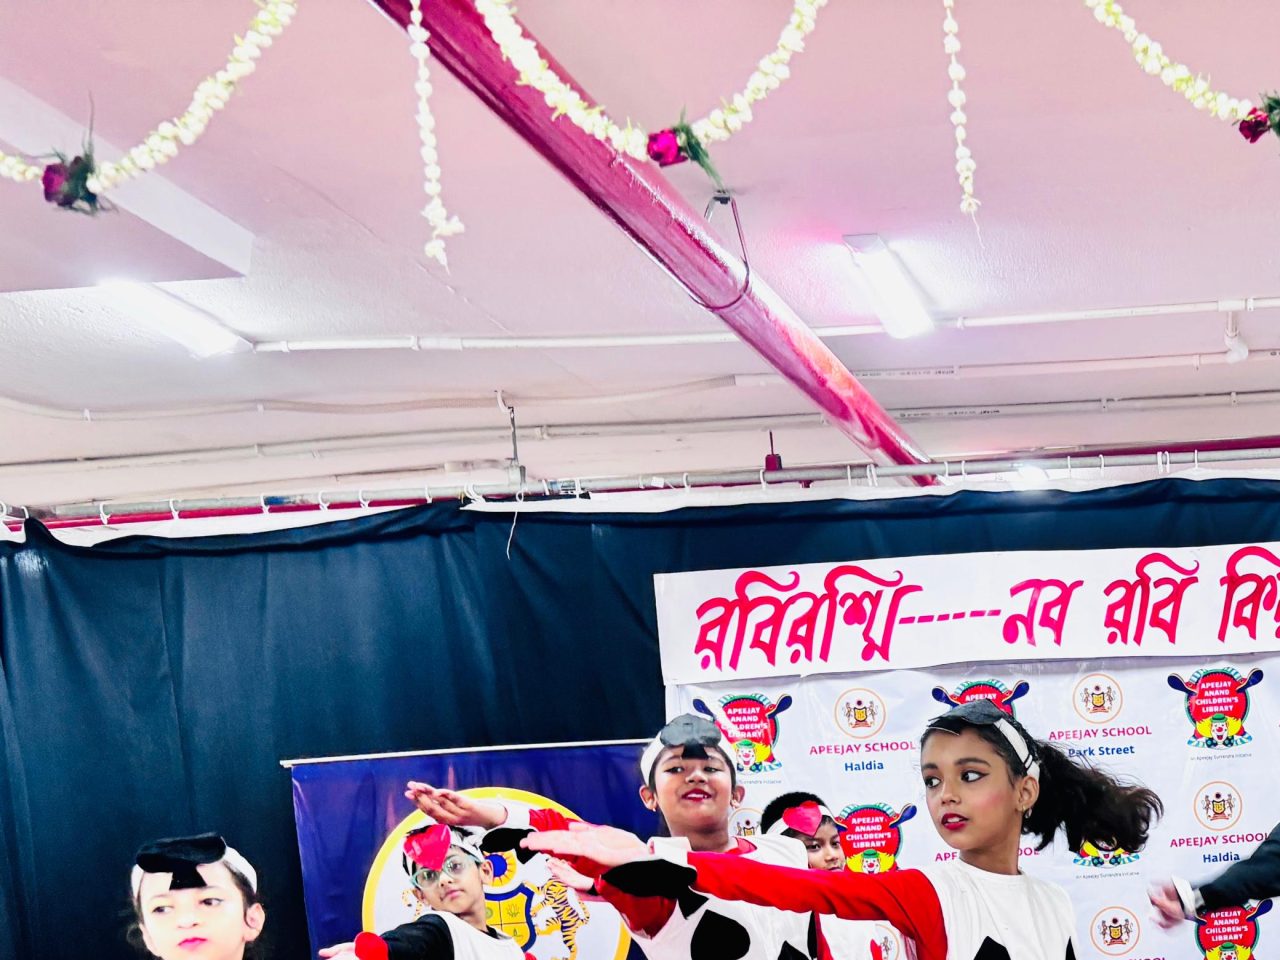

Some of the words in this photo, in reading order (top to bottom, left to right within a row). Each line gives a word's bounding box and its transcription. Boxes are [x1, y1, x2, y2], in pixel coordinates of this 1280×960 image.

[1003, 579, 1084, 646] নব
[1104, 552, 1200, 646] রবি
[1204, 689, 1230, 697] ANAND
[1195, 697, 1239, 705] CHILDREN'S
[727, 707, 760, 715] APEEJAY
[1202, 705, 1234, 713] LIBRARY
[730, 715, 758, 723] ANAND
[1049, 728, 1099, 741] APEEJAY
[1102, 725, 1152, 738] SCHOOL
[809, 744, 862, 756] APEEJAY
[865, 741, 916, 753] SCHOOL
[1068, 747, 1095, 758] Park
[1098, 745, 1135, 756] Street
[844, 760, 884, 772] Haldia
[852, 816, 884, 825] APEEJAY
[846, 832, 891, 841] CHILDREN'S
[852, 841, 886, 849] LIBRARY
[1170, 835, 1218, 848] APEEJAY
[1203, 851, 1240, 863] Haldia
[1210, 910, 1242, 918] APEEJAY
[1205, 925, 1249, 935] CHILDREN'S
